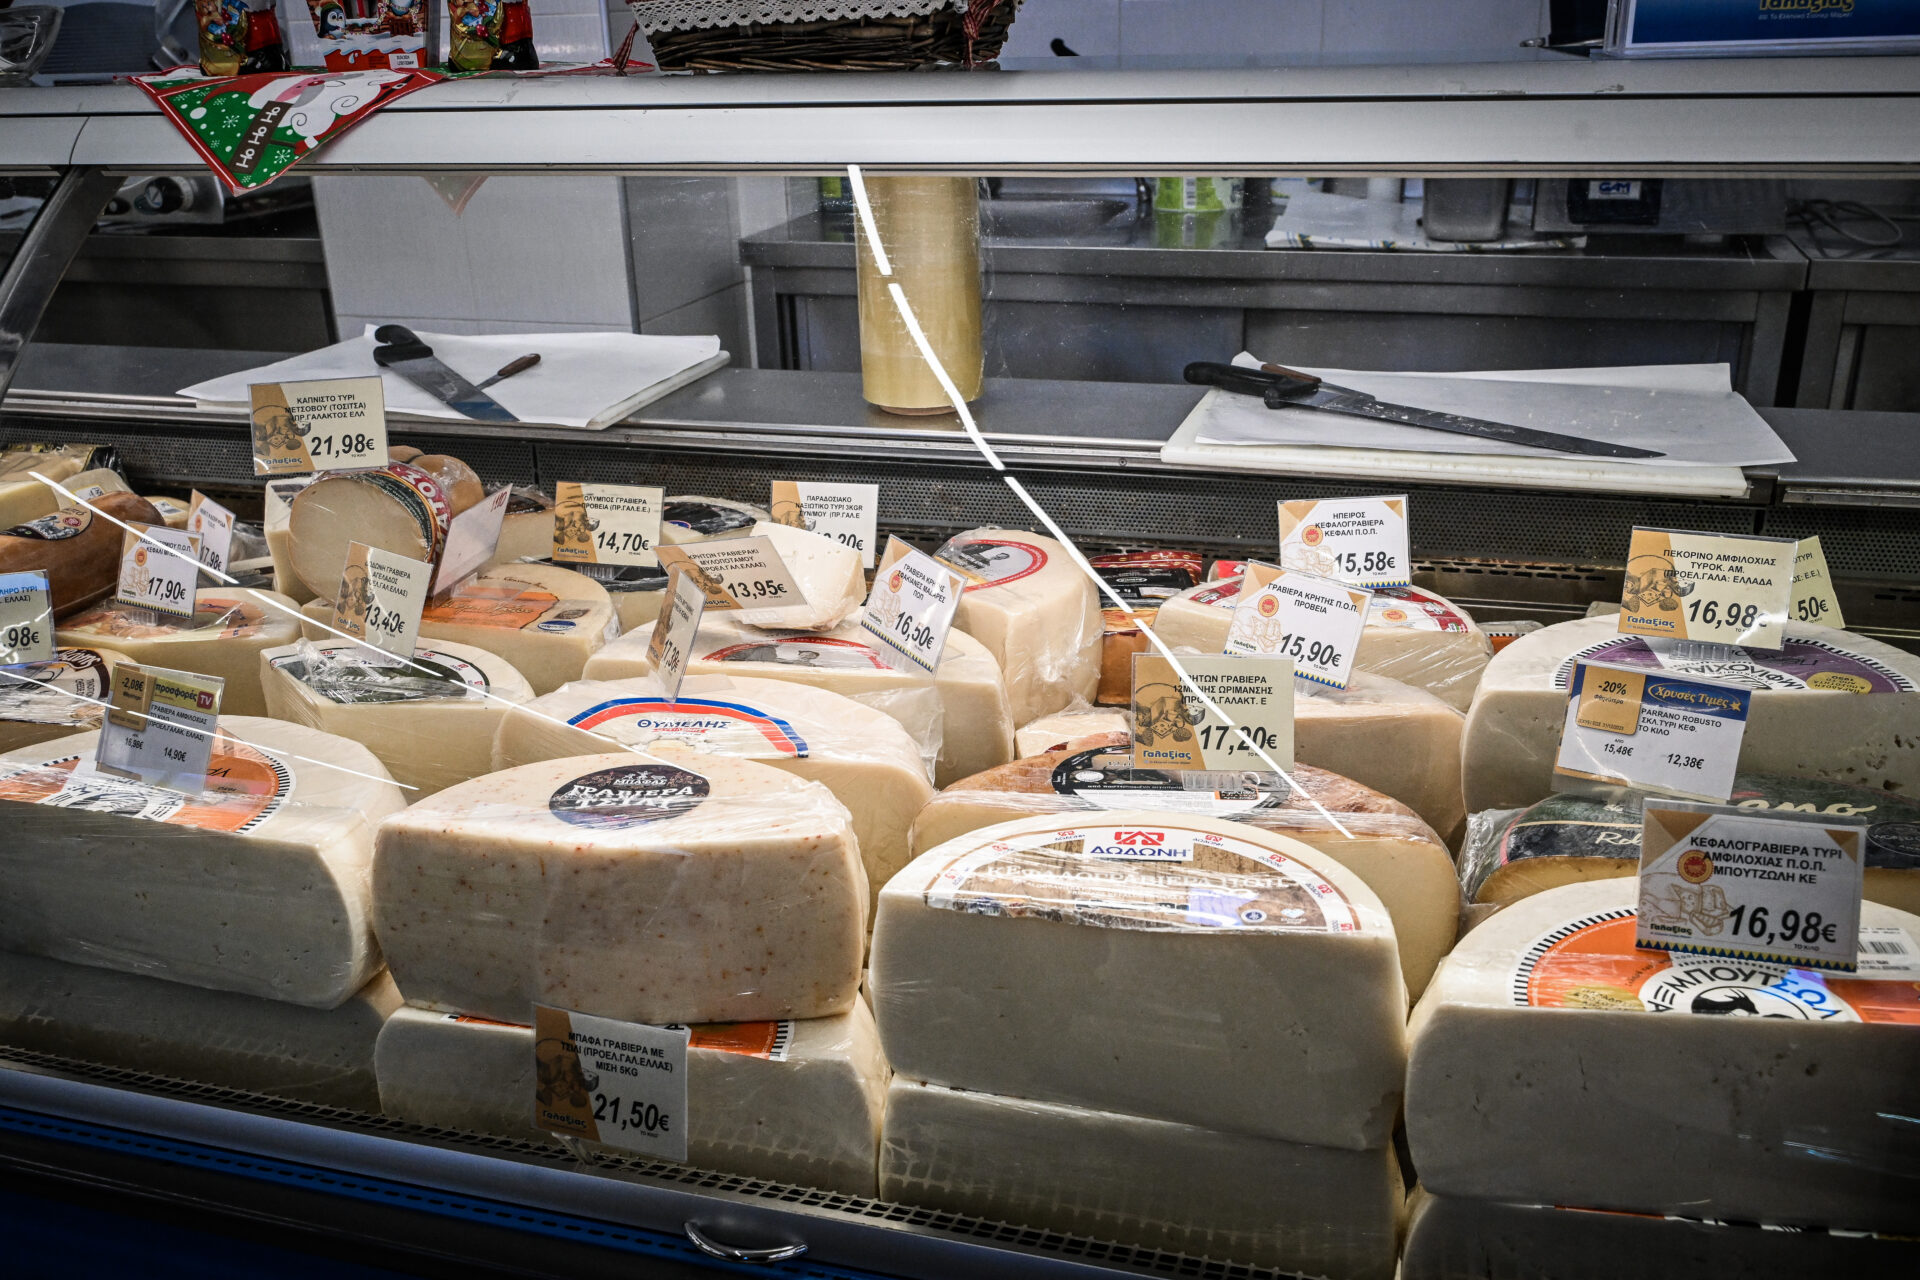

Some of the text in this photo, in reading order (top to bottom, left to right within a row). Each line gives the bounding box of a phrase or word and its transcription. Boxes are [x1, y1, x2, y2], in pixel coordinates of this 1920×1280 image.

[296, 394, 355, 404] ΚΑΠΝΙΣΤΟ ΤΥΡΙ
[285, 403, 366, 414] ΜΕΤΣΟΒΟΥ (ΤΟΣΙΤΣΑ)
[311, 433, 375, 458] 21,98€
[616, 497, 647, 505] ΓΡΑΒΙΕΡΑ
[1315, 520, 1384, 528] ΚΕΦΑΛΟΓΡΑΒΙΕΡΑ
[1333, 512, 1366, 520] ΗΠΕΙΡΟΣ
[598, 532, 650, 554] 14,70€
[688, 549, 760, 560] ΚΡΗΤΩΝ ΓΡΑΒΙΕΡΑΚΙ
[700, 556, 754, 566] ΜΥΛΟΠΟΤΑΜΟΥ
[1664, 550, 1776, 566] ΠΕΚΟΡΙΝΟ ΑΜΦΙΛΟΧΙΑΣ
[1334, 551, 1396, 576] 15,58€
[1690, 561, 1745, 574] ΤΥΡΟΚ. ΑΜ.
[372, 571, 398, 585] ΑΓΕΛΑΔΟΣ
[387, 566, 411, 580] ΓΡΑΒΙΕΡΑ
[897, 570, 924, 590] ΣΦΑΚΙΑΝΕΣ
[904, 563, 926, 583] ΓΡΑΒΙΕΡΑ
[1732, 576, 1773, 586] ΕΛΛΑΔΑ
[21, 585, 38, 593] ΤΥΡΙ
[149, 577, 186, 601] 17,90€
[727, 580, 788, 600] 13,95€
[913, 589, 924, 601] ΠΟΠ
[4, 594, 31, 604] ΕΛΛΑΣ)
[1268, 583, 1358, 613] ΓΡΑΒΙΕΡΑ ΚΡΗΤΗΣ Π.Ο.Π.
[1294, 599, 1328, 614] ΠΡΟΒΕΙΑ
[1788, 597, 1829, 622] ,50€
[364, 604, 406, 634] 13,40€
[1627, 615, 1675, 629] Γαλαξίας
[895, 612, 934, 650] 16,50€
[1280, 633, 1342, 667] 15,90€
[1221, 675, 1267, 684] ΓΡΑΒΙΕΡΑ
[122, 677, 212, 705] -2,08€ προσφορές TV
[1219, 686, 1273, 695] ΩΡΙΜΑΝΣΗΣ
[1598, 681, 1729, 709] -20% Χρυσές Τιμές
[1181, 696, 1267, 705] (ΠΡΟΛ.ΓΑΛΑΚΤ. Ε
[151, 704, 176, 716] ΓΡΑΒΙΕΡΑ
[1641, 708, 1722, 728] PARRANO ROBUSTO
[637, 719, 732, 728] ΘΥΜΕΛΗΣ
[1638, 724, 1670, 736] ΤΟ ΚΙΛΟ
[1641, 716, 1697, 733] ΣΚΛ.ΤΥΡΙ ΚΕΦ.
[125, 737, 144, 750] 16,98€
[1200, 725, 1278, 756] 17,20€
[164, 746, 187, 762] 14,90€
[1143, 750, 1192, 760] Γαλαξίας
[1604, 743, 1634, 757] 15,48€
[1667, 753, 1704, 770] 12,38€
[1090, 846, 1188, 858] ΔΩΔΩΝΗ
[1690, 836, 1842, 859] ΚΕΦΑΛΟΓΡΑΒΙΕΡΑ ΤΥΡΙ
[1703, 851, 1826, 872] ΑΜΦΙΛΟΧΙΑΣ Π.Ο.Π.
[1714, 866, 1817, 885] ΜΠΟΥΤΖΩΛΗ ΚΕ
[1650, 923, 1692, 936] Γαλαξίας
[1729, 904, 1838, 946] 16,98€
[568, 1032, 664, 1059] ΜΠΑΦΑ ΓΡΑΒΙΕΡΑ ΜΕ
[584, 1047, 673, 1073] (ΠΡΟΕΛ.ΓΑΛ.ΕΛΛΑΣ)
[596, 1061, 638, 1077] ΜΙΣΗ 5KG
[543, 1110, 587, 1128] Γαλαξίας
[594, 1094, 670, 1132] 21,50€
